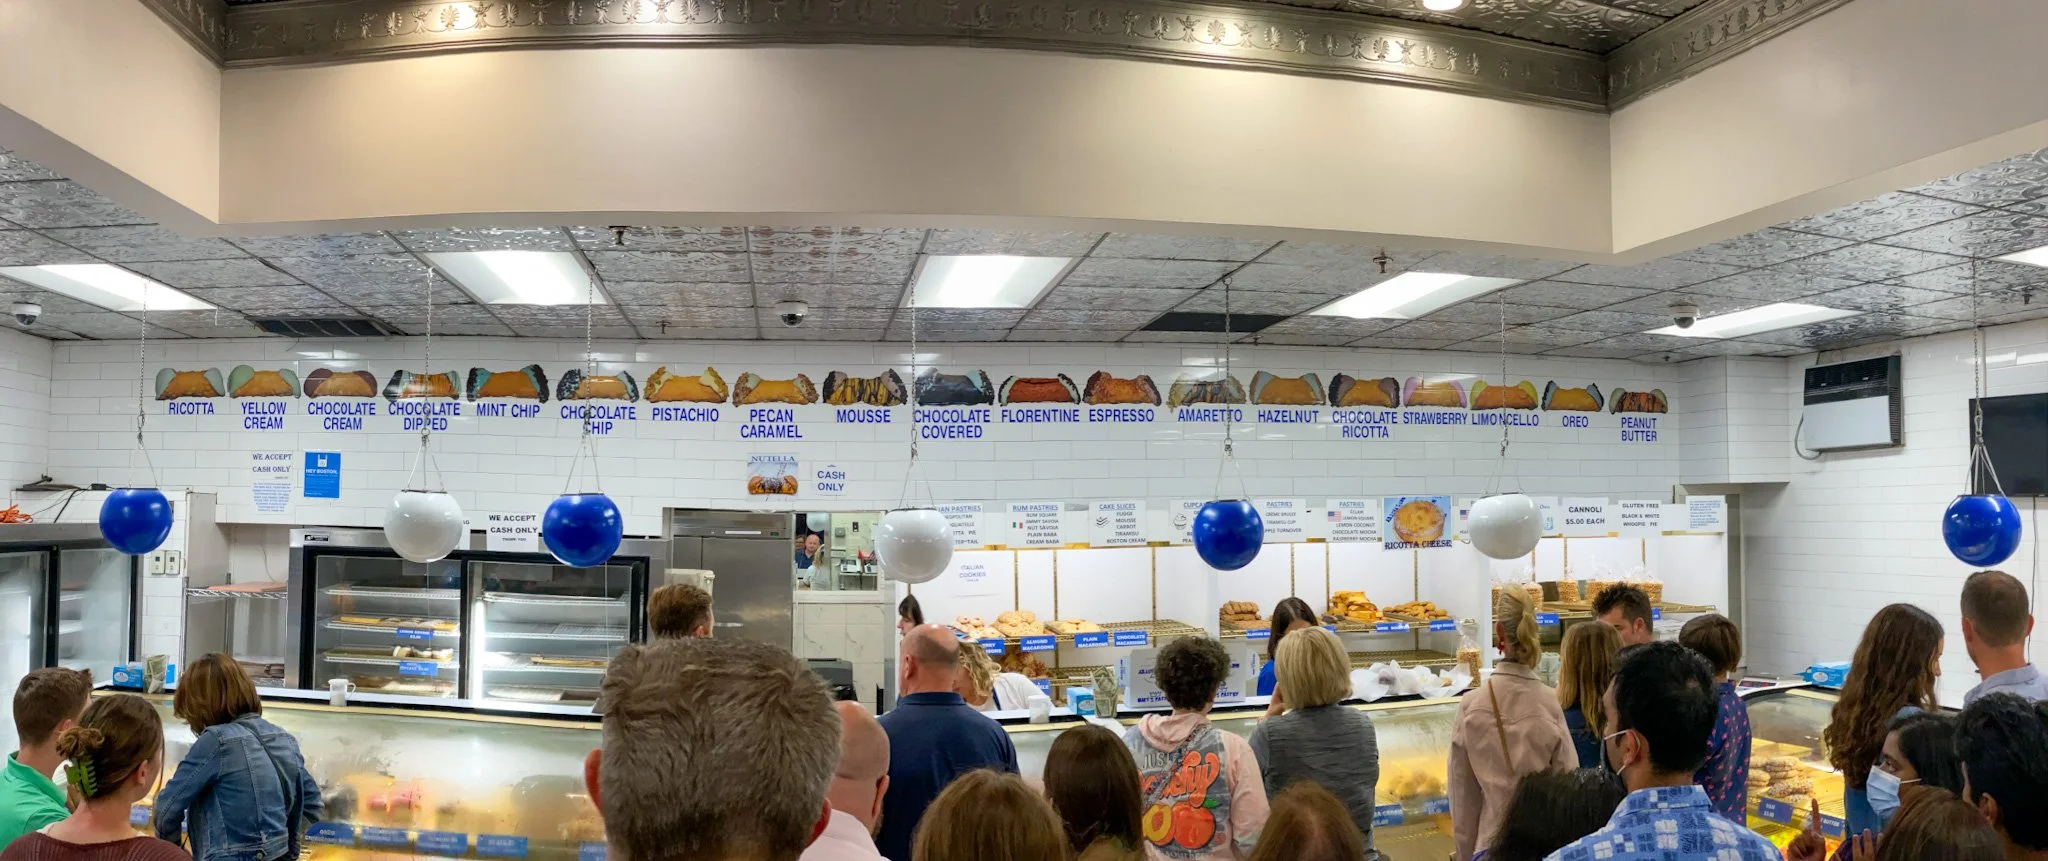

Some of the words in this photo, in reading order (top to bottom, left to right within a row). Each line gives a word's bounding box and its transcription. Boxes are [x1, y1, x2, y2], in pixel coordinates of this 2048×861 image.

[169, 402, 214, 415] RICOTTA
[241, 402, 286, 415] YELLOW
[307, 402, 376, 416] CHOCOLATE
[388, 402, 460, 416] CHOCOLATE
[477, 403, 507, 417] MINT
[511, 404, 540, 418] CHIP
[652, 407, 719, 422] PISTACHIO
[1001, 408, 1080, 423] FLORENTINE
[1089, 408, 1154, 422] ESPRESSO
[244, 416, 283, 430] CREAM
[750, 409, 793, 423] PECAN
[836, 409, 891, 423] MOUSSE
[915, 409, 990, 423] CHOCOLATE
[1178, 409, 1243, 423] AMARETTO
[1258, 410, 1319, 423] HAZELNUT
[1332, 411, 1398, 425] CHOCOLATE
[1403, 412, 1468, 425] STRAWBERRY
[1562, 416, 1589, 428] OREO
[1621, 417, 1657, 429] PEANUT
[324, 417, 362, 430] CREAM
[741, 424, 803, 439] CARAMEL
[921, 425, 983, 439] COVERED
[1342, 425, 1389, 439] RICOTTA
[1621, 430, 1657, 442] BUTTER
[272, 465, 291, 473] ONLY
[817, 470, 846, 480] CASH
[817, 482, 845, 491] ONLY
[1384, 540, 1420, 549] RICOTTA
[1421, 539, 1452, 548] CHEESE
